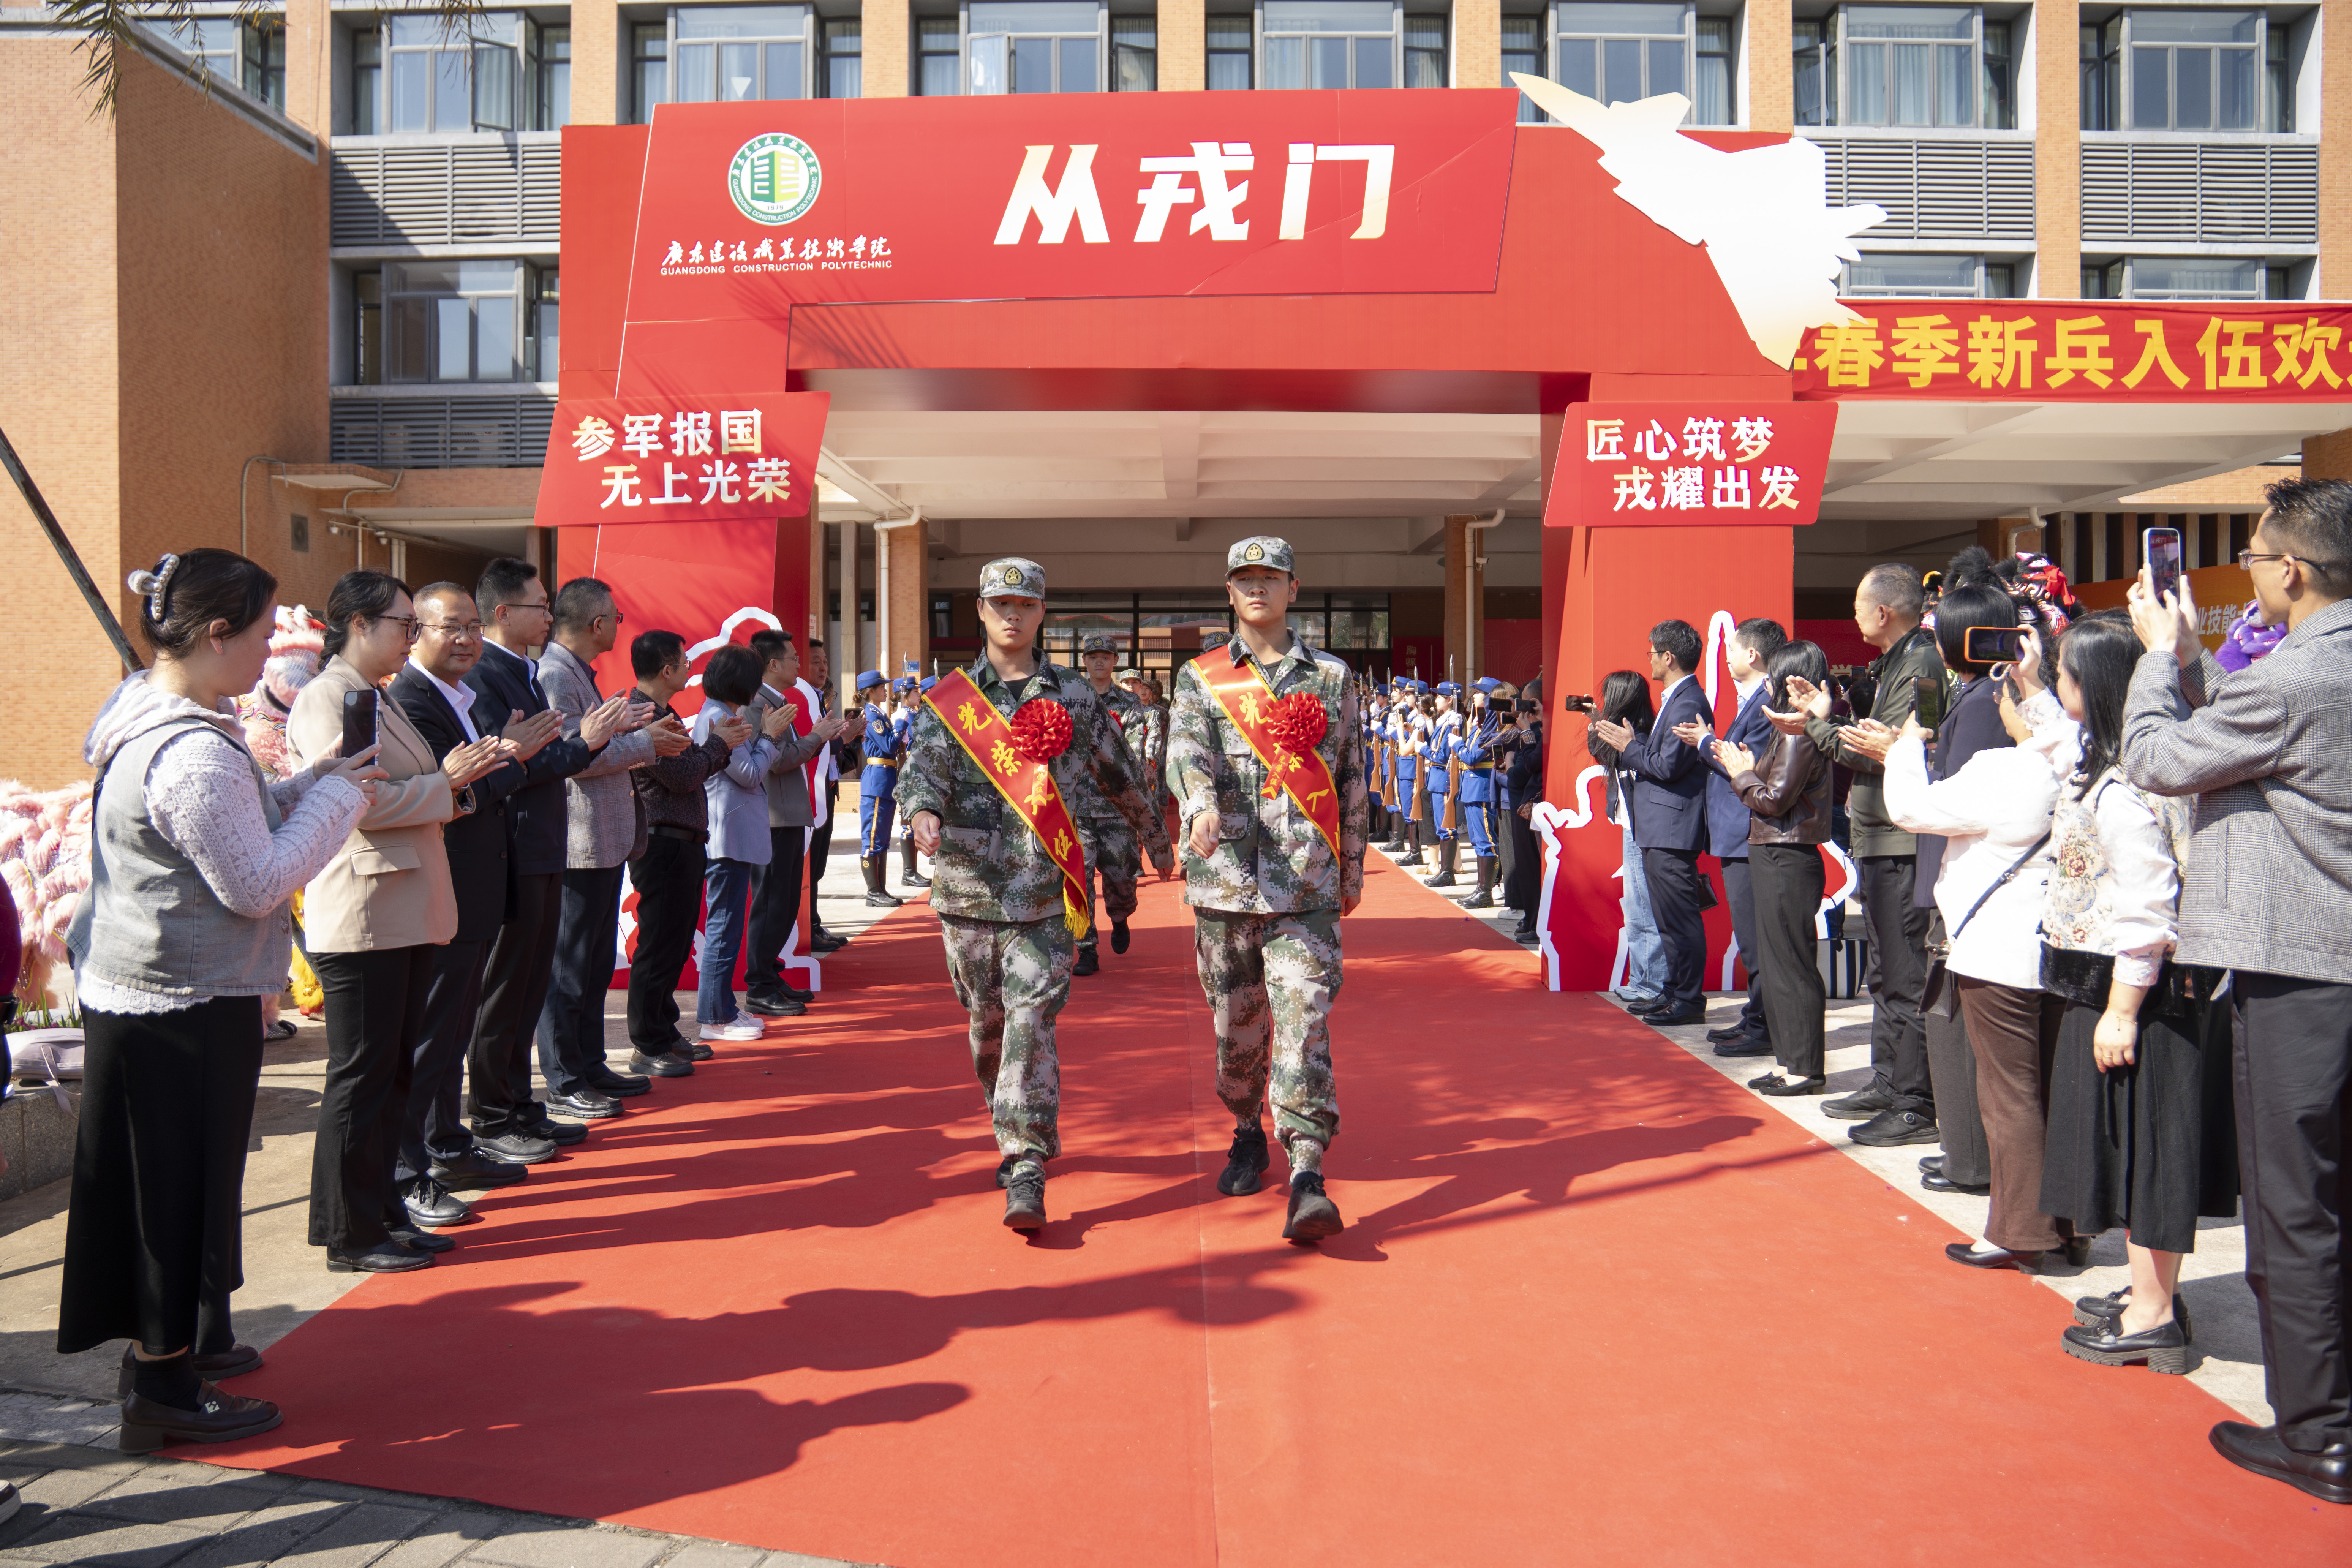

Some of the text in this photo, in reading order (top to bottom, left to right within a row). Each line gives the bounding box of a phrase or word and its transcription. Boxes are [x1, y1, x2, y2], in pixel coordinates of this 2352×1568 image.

[732, 176, 817, 221] GUANGDONG CONSTRUCTION POLYTECHNIC
[993, 141, 1395, 245] 从戎门
[660, 260, 892, 276] GUANGDONG CONSTRUCTION POLYTECHNIC
[1793, 314, 2352, 390] 春季新兵入伍欢
[572, 408, 762, 461] 参军报国
[1586, 416, 1775, 463] 匠心筑梦
[600, 457, 791, 509] 无上光荣
[1612, 465, 1801, 511] 戎耀出发
